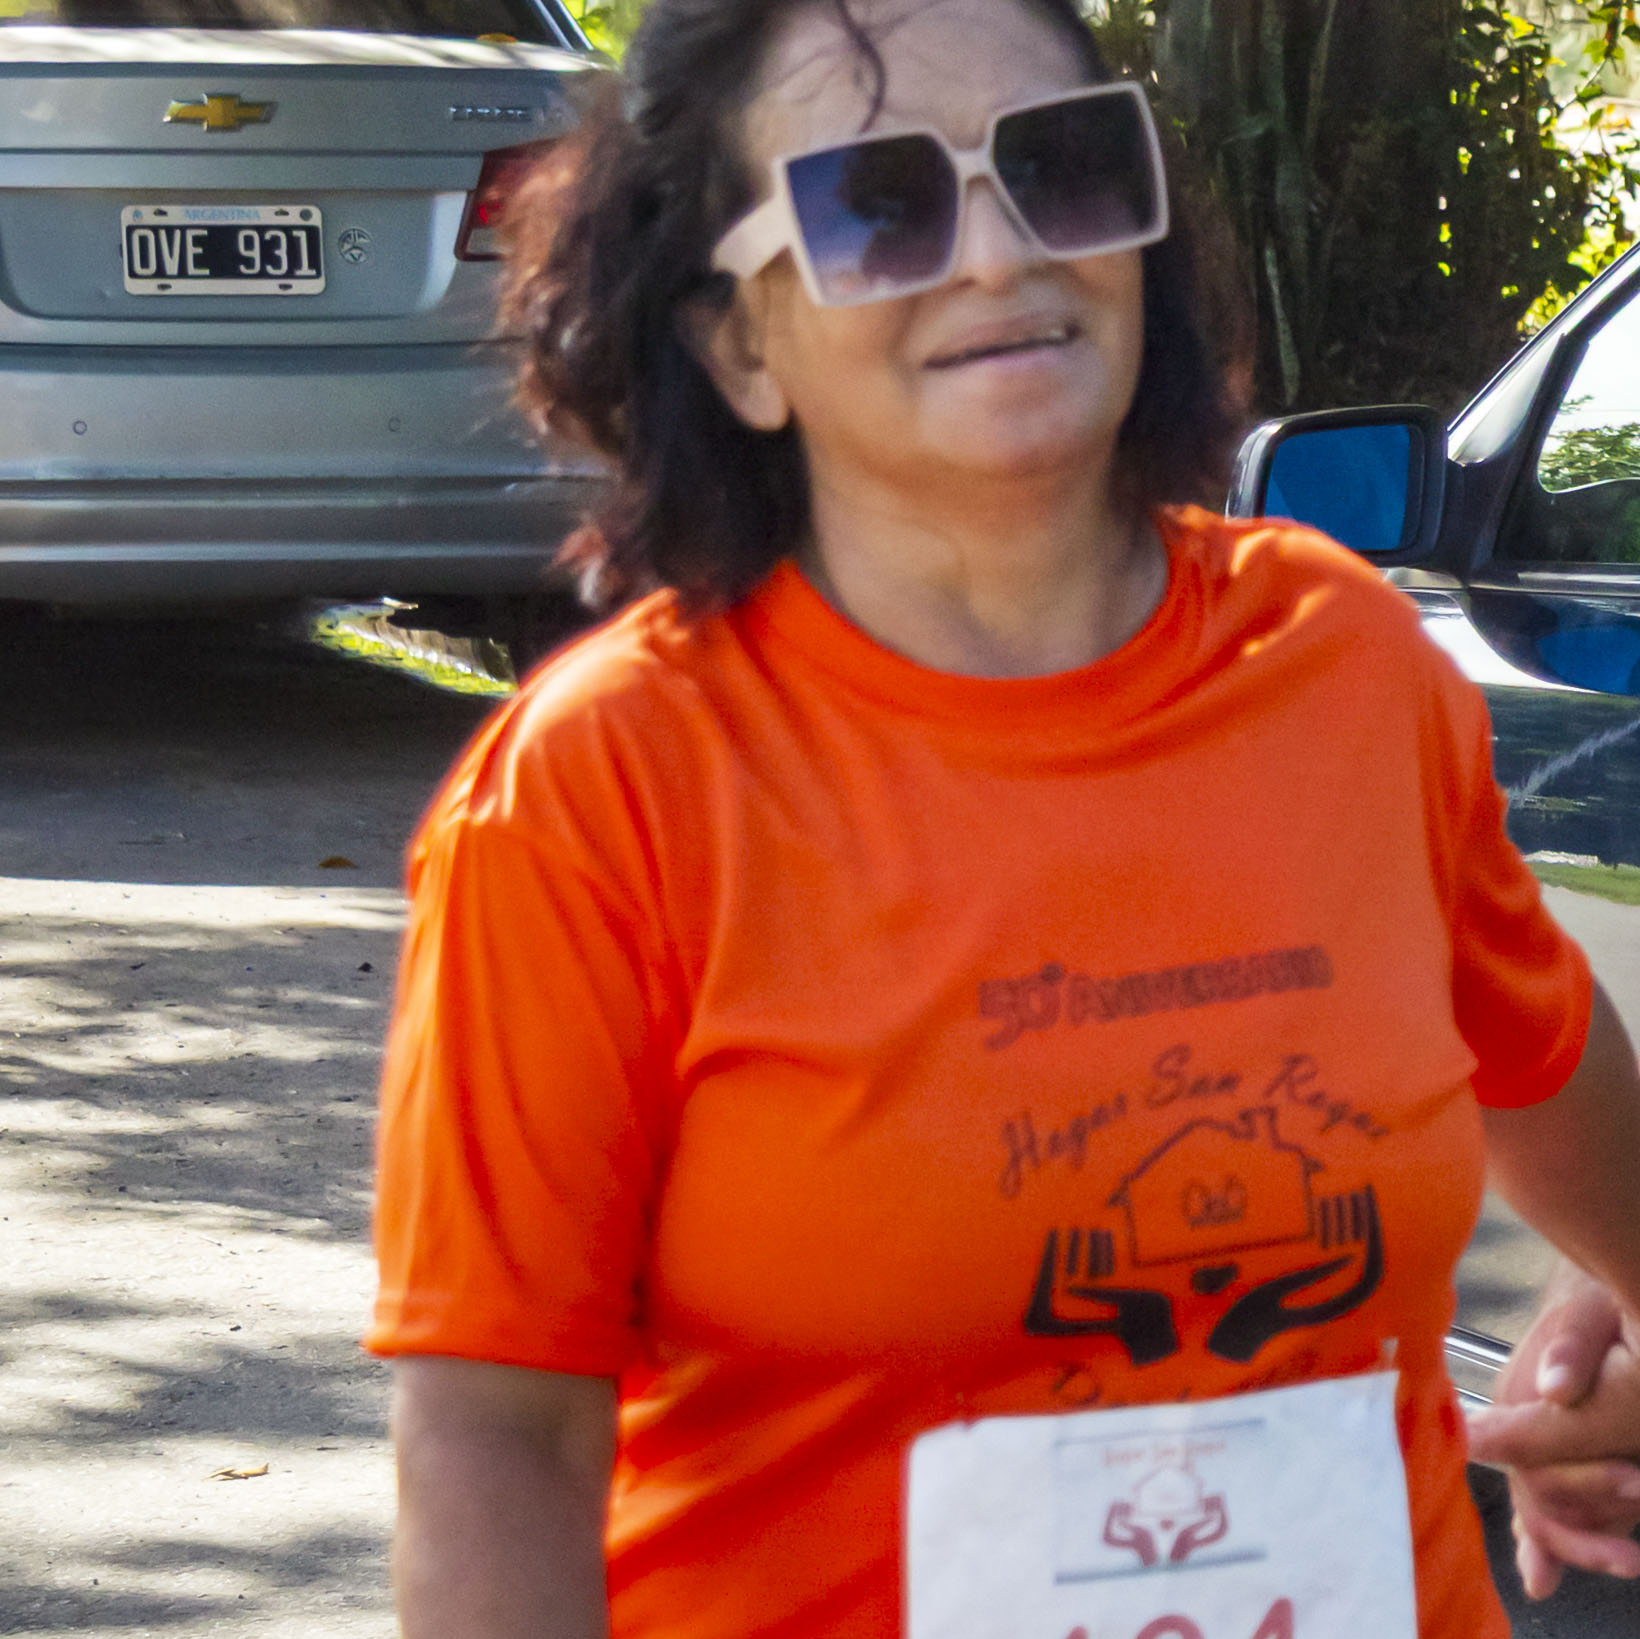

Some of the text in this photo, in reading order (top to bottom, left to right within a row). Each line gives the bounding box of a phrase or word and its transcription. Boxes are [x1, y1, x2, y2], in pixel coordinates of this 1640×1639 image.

[184, 208, 261, 221] ARGENTINA
[132, 228, 317, 276] OVE 931
